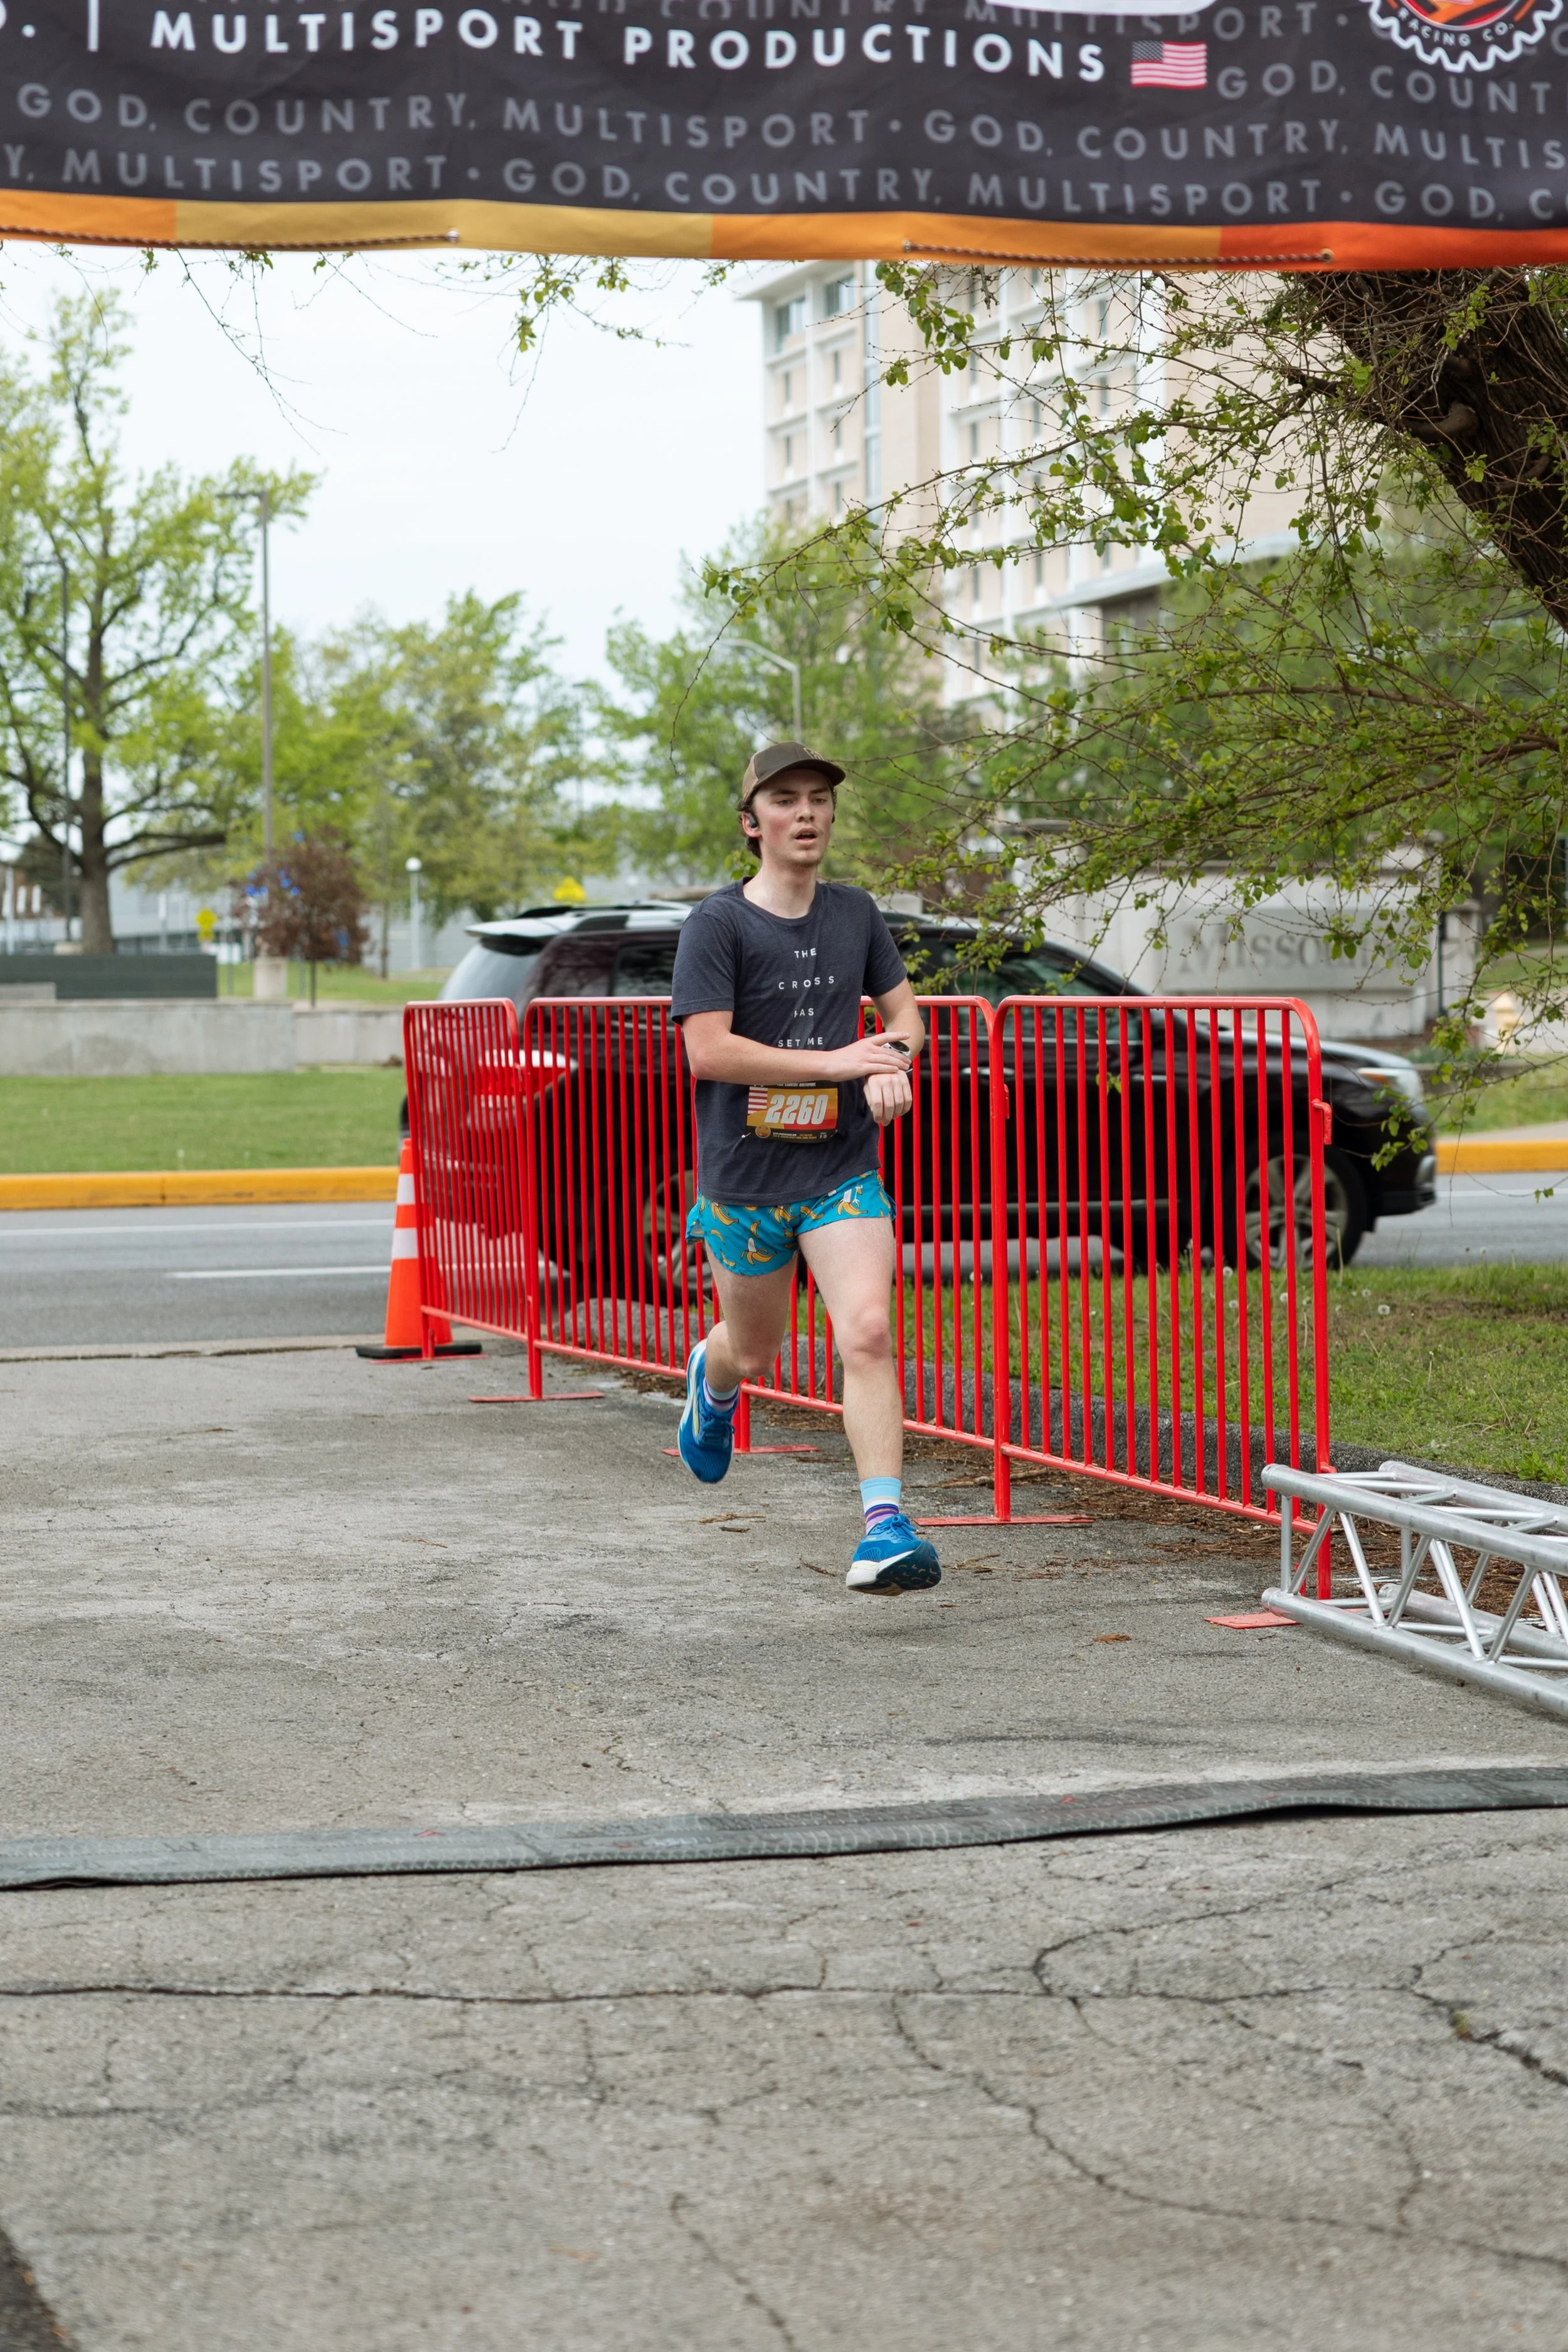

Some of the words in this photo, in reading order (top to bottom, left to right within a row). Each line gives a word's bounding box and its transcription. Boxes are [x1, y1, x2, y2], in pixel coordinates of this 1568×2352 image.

[151, 9, 583, 60] MULTISPORT
[625, 23, 1105, 82] PRODUCTIONS
[1397, 7, 1471, 47] RACING
[1216, 60, 1347, 100] GOD,
[18, 83, 156, 131] GOD,
[184, 92, 477, 134] COUNTRY,
[504, 97, 870, 148] MULTISPORT
[924, 109, 1054, 157] GOD,
[1078, 119, 1348, 161] COUNTRY,
[1374, 124, 1566, 169] MULTIS
[63, 149, 447, 193] MULTISPORT
[504, 158, 640, 203] GOD,
[665, 168, 941, 205] COUNTRY,
[968, 172, 1320, 216] MULTISPORT
[1375, 181, 1505, 223] GOD,
[794, 948, 817, 958] THE
[778, 976, 834, 990] CROSS
[778, 1039, 801, 1047] SET
[807, 1037, 823, 1046] ME
[765, 1094, 829, 1125] 2260
